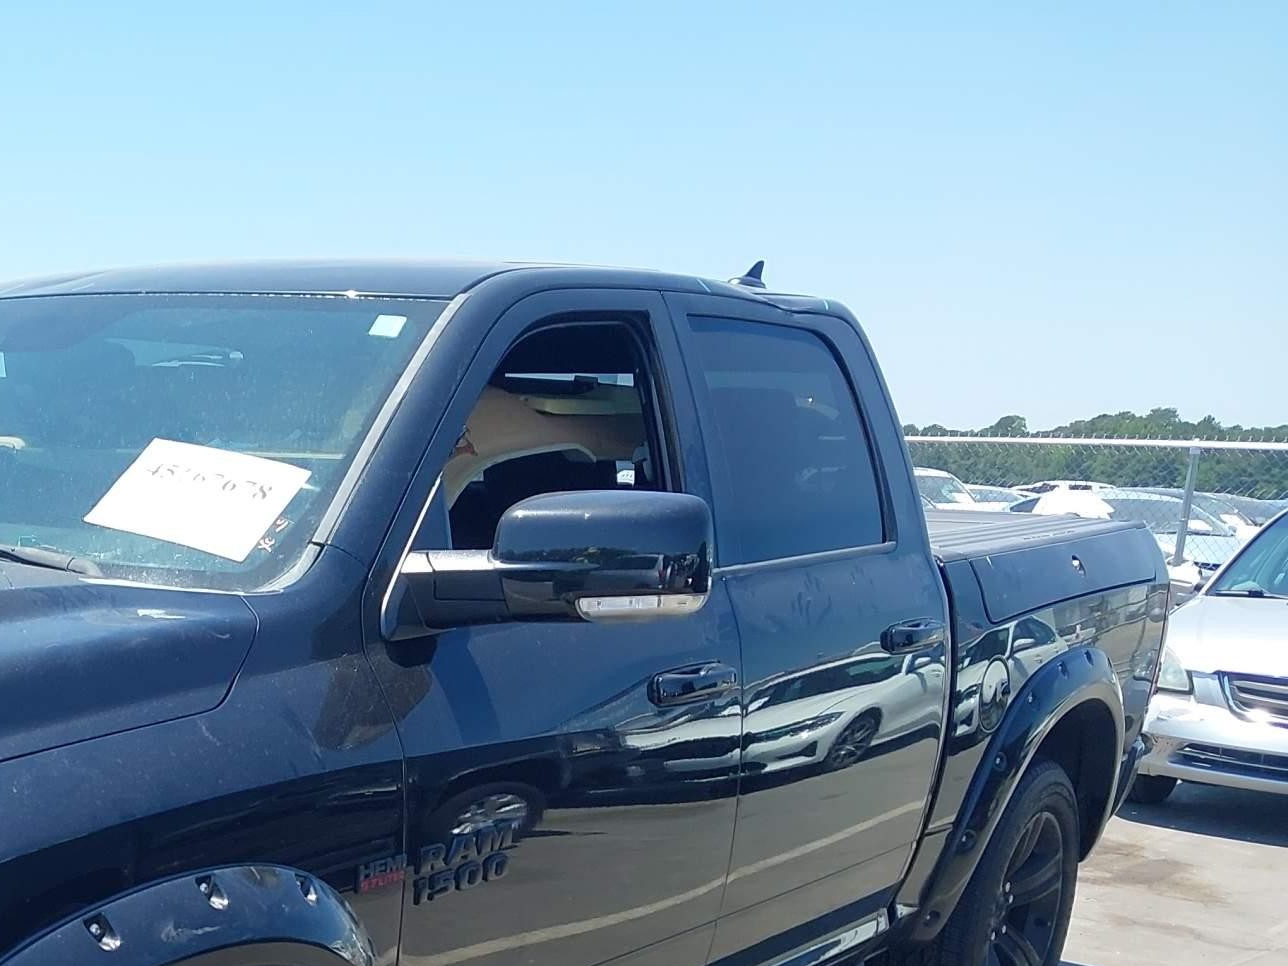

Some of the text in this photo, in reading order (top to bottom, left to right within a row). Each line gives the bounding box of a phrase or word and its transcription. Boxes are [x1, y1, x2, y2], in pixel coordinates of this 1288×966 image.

[359, 853, 408, 881] HEMI
[415, 818, 521, 875] RAM
[413, 853, 510, 905] 1500
